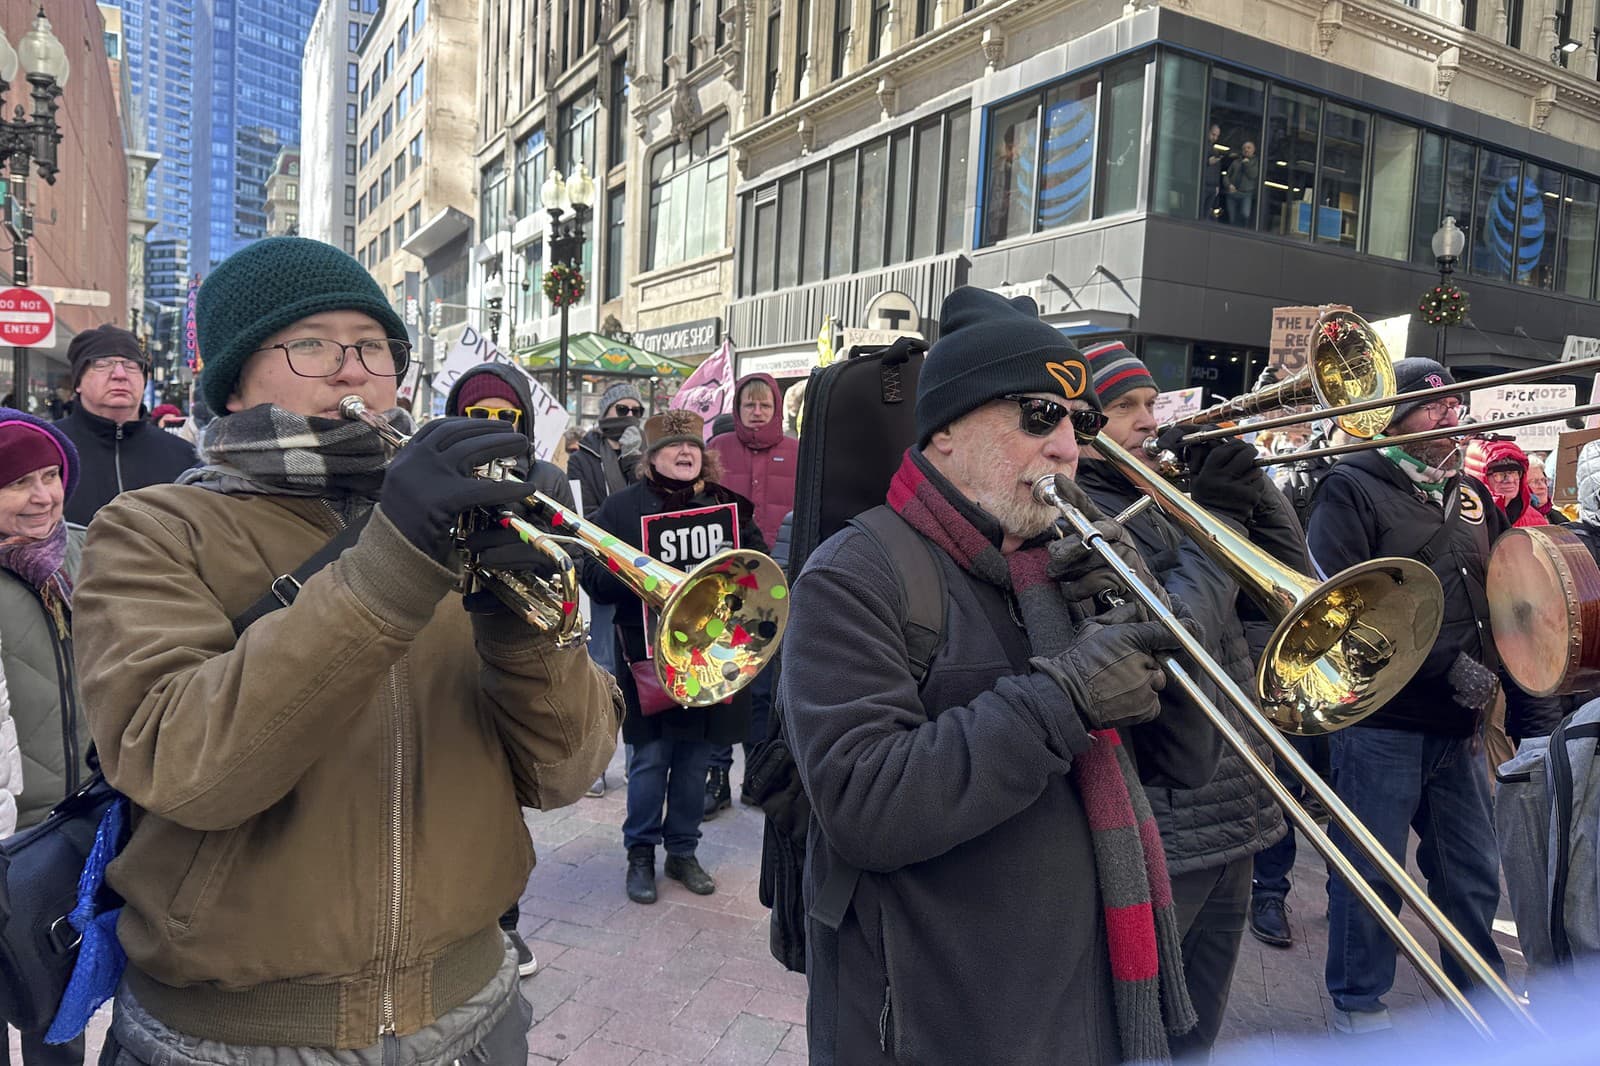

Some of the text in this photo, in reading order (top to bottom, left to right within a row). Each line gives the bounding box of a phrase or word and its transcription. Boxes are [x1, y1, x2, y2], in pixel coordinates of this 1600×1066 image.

[0, 300, 42, 310] DO NOT
[4, 324, 39, 334] ENTER
[187, 280, 196, 372] PARAMOUNT
[1276, 317, 1302, 329] THE
[644, 334, 662, 352] CITY
[662, 328, 689, 350] SMOKE
[690, 325, 714, 346] SHOP
[1561, 335, 1600, 361] AT&
[660, 523, 724, 564] STOP
